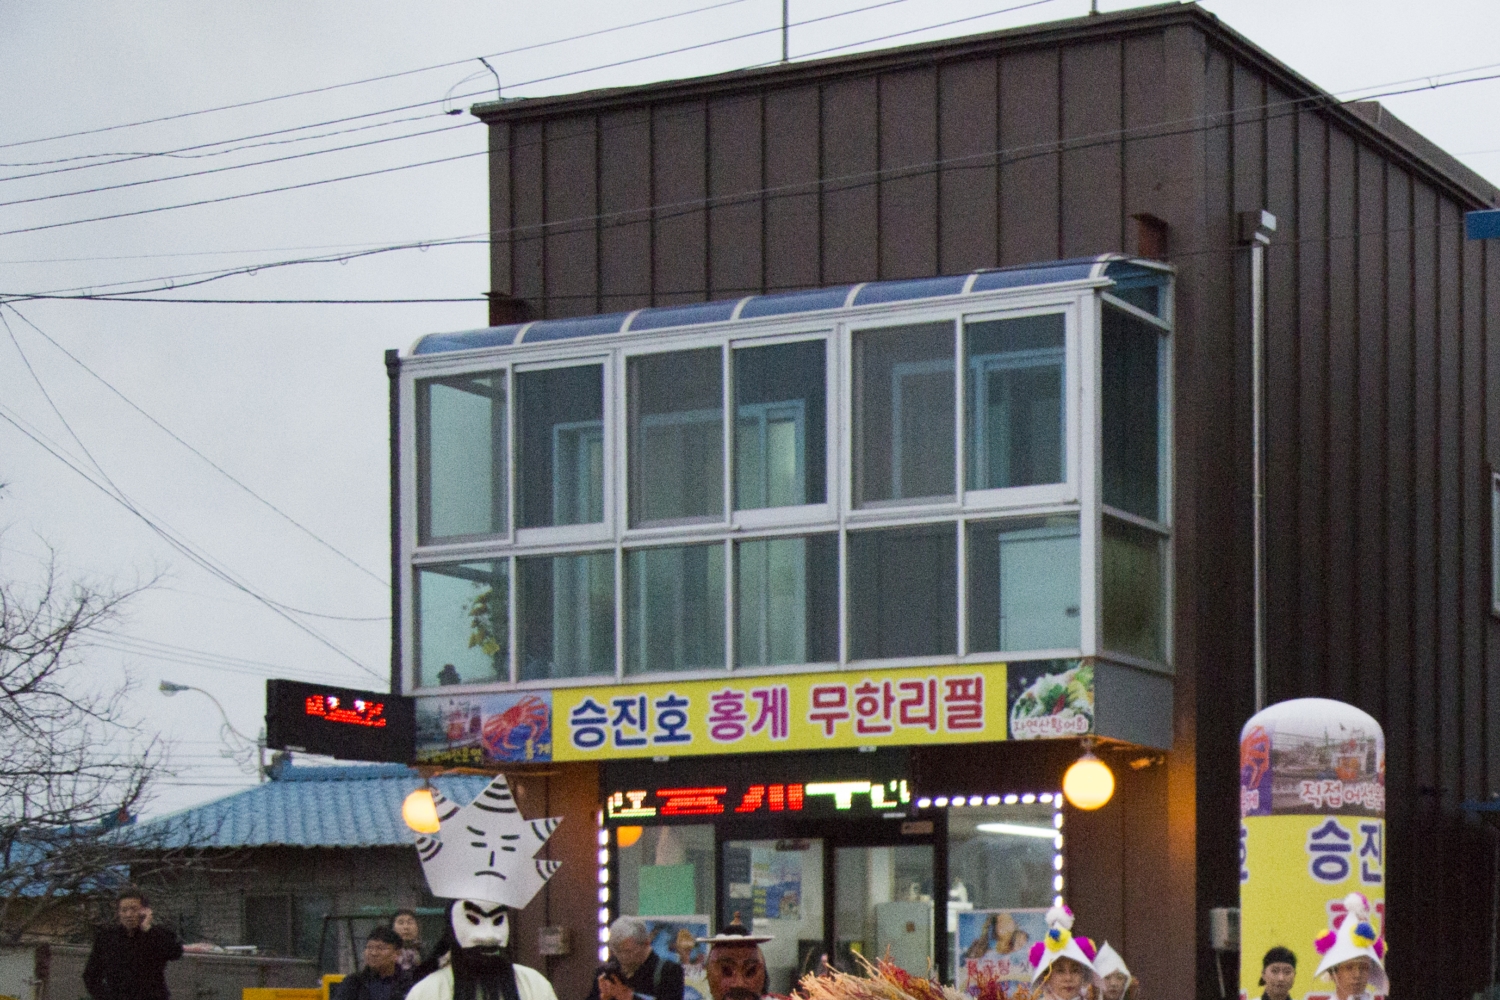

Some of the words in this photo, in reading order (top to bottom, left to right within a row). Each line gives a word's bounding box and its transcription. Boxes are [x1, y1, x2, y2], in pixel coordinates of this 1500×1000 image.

[570, 694, 692, 748] 승진호
[708, 687, 788, 741] 홍게
[809, 676, 983, 736] 무한리필
